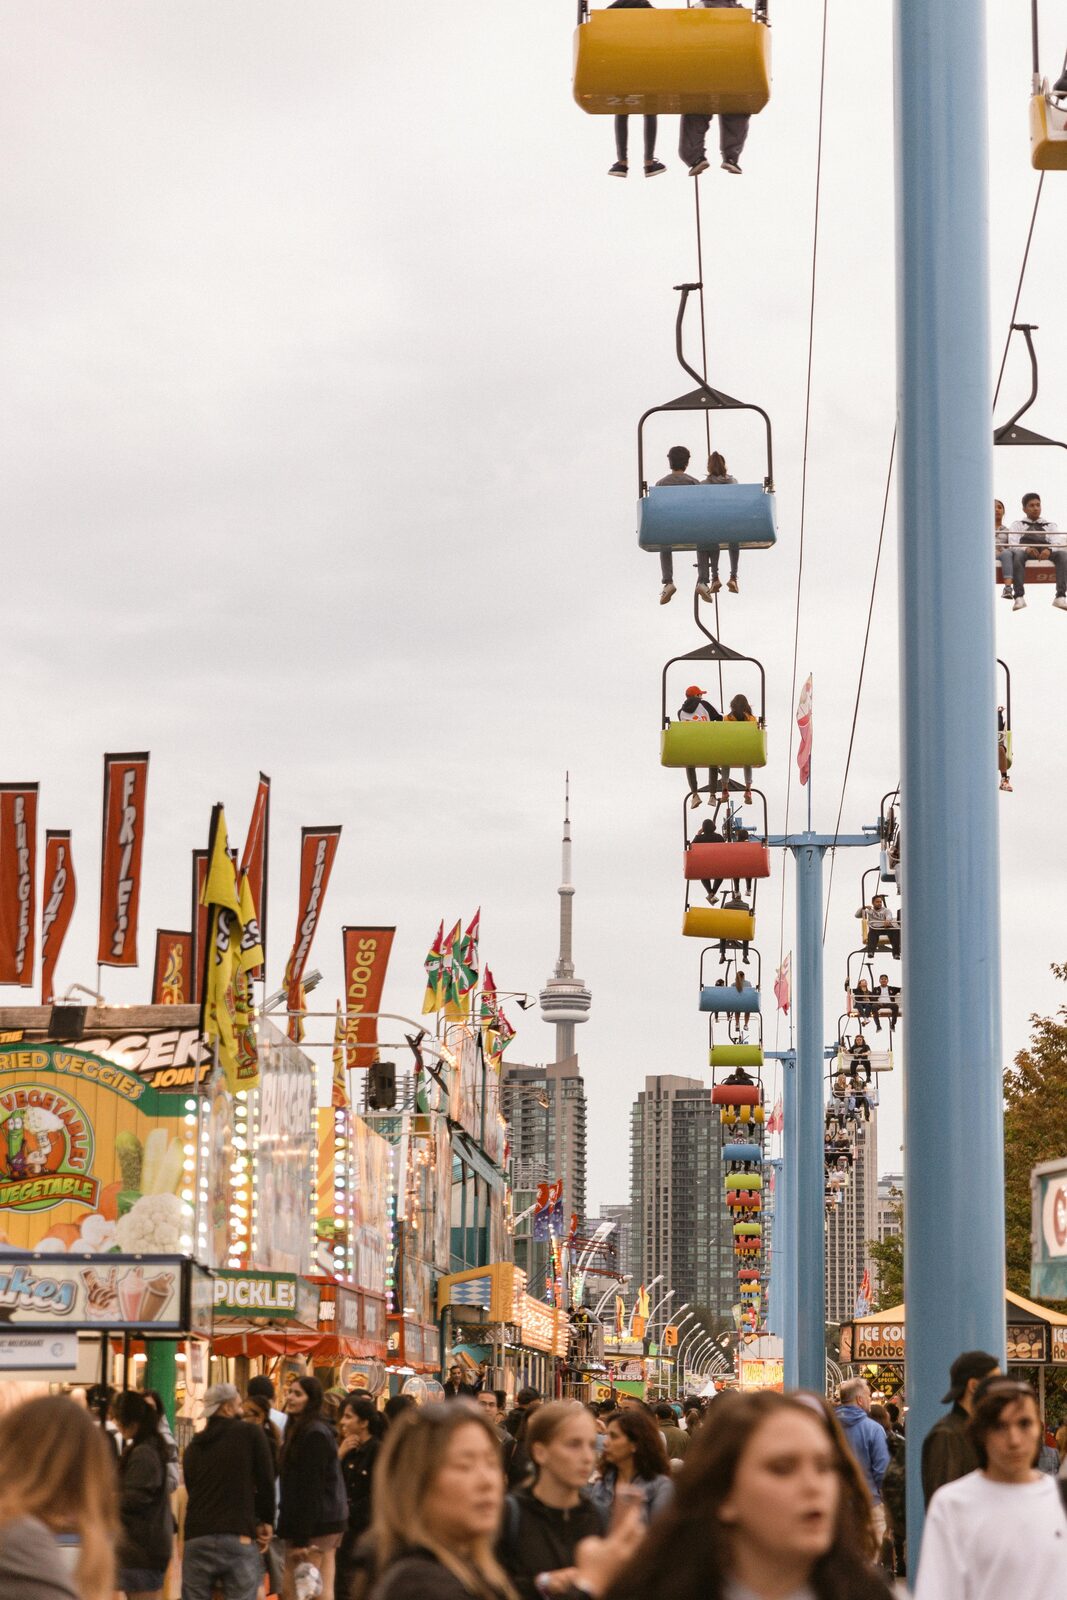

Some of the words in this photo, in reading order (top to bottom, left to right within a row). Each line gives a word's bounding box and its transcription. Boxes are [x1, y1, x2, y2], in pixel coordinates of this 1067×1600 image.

[112, 769, 136, 956] FRIES
[806, 850, 813, 861] 7
[14, 796, 29, 975] BURGERS
[349, 938, 377, 999] DOGS
[54, 1053, 144, 1099] VEGGIES
[151, 1065, 211, 1088] JOINT
[789, 1061, 794, 1069] 8
[859, 1327, 880, 1342] ICE
